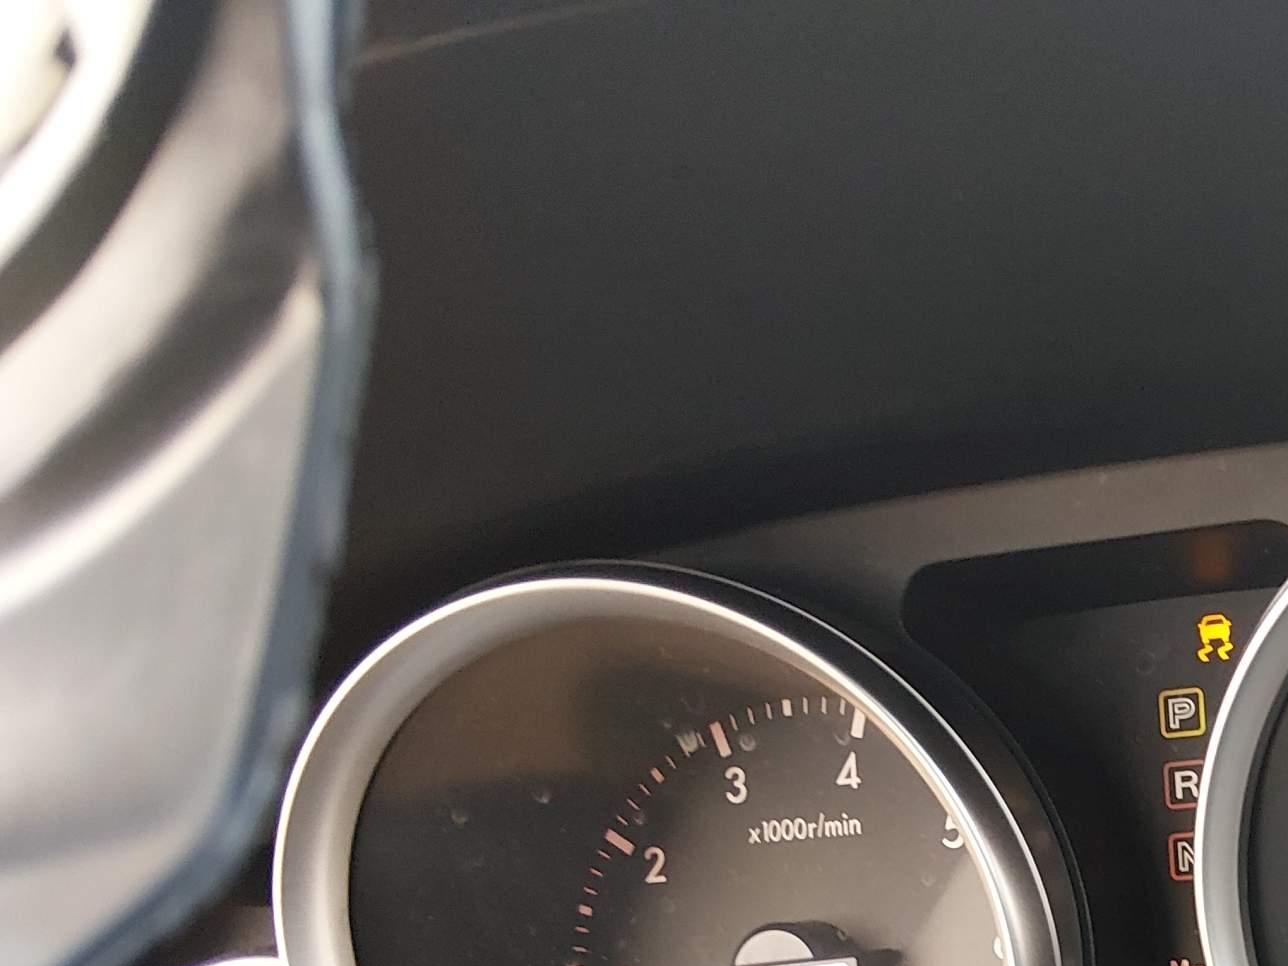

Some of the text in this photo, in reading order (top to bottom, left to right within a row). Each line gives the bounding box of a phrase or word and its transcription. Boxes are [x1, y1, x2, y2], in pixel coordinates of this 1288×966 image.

[1167, 698, 1196, 729] P
[724, 766, 748, 804] 3
[836, 752, 861, 790] 4
[1173, 770, 1200, 800] R
[748, 813, 862, 844] x1000r/min
[644, 846, 668, 884] 2
